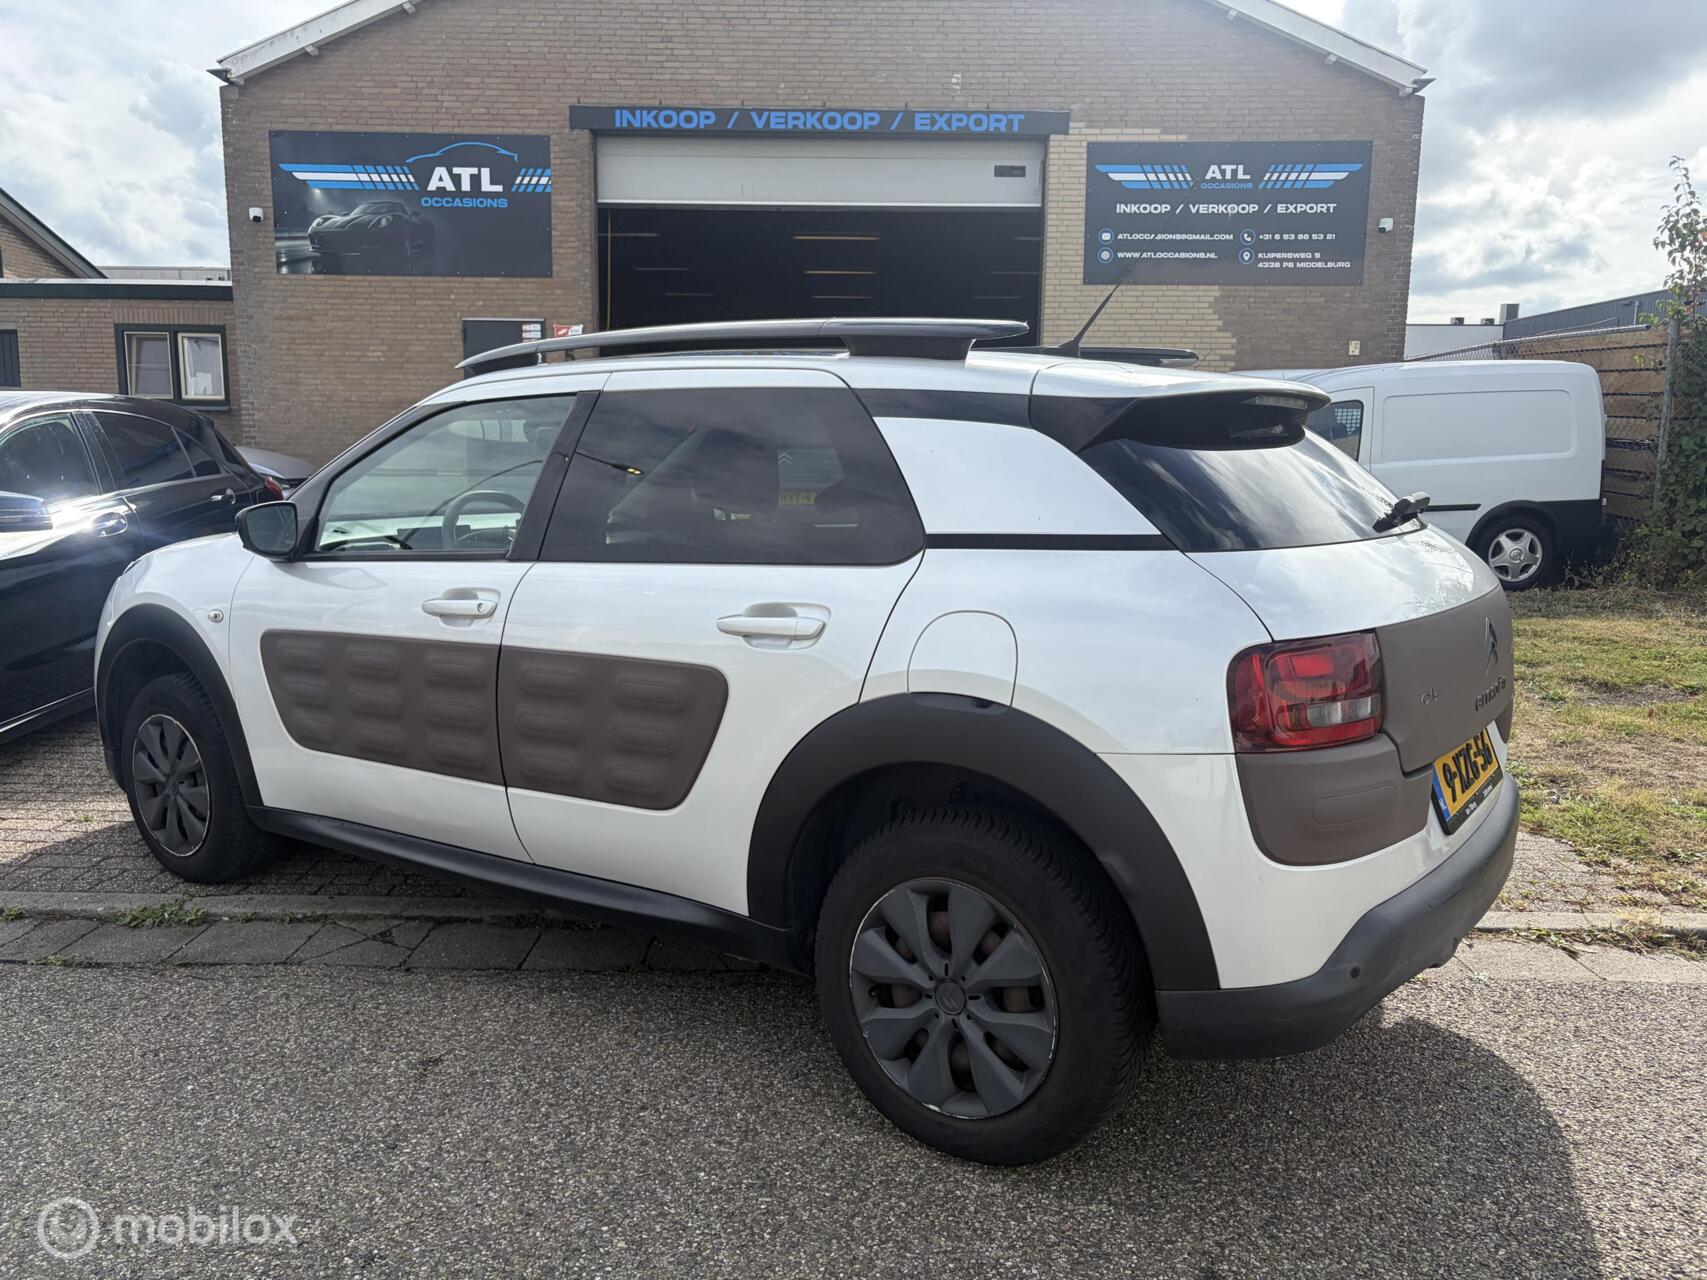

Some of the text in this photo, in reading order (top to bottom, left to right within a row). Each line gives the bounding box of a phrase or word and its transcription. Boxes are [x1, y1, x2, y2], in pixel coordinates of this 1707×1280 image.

[614, 108, 1025, 132] INKOOP / VERKOOP / EXPORT
[426, 166, 504, 193] ATL
[1204, 164, 1251, 180] ATL
[1200, 182, 1253, 190] OCCASIONS
[420, 196, 509, 209] OCCASIONS
[1115, 203, 1337, 214] INKOOP / VERKOOP / EXPORT
[1442, 730, 1494, 803] 9-XZG-56
